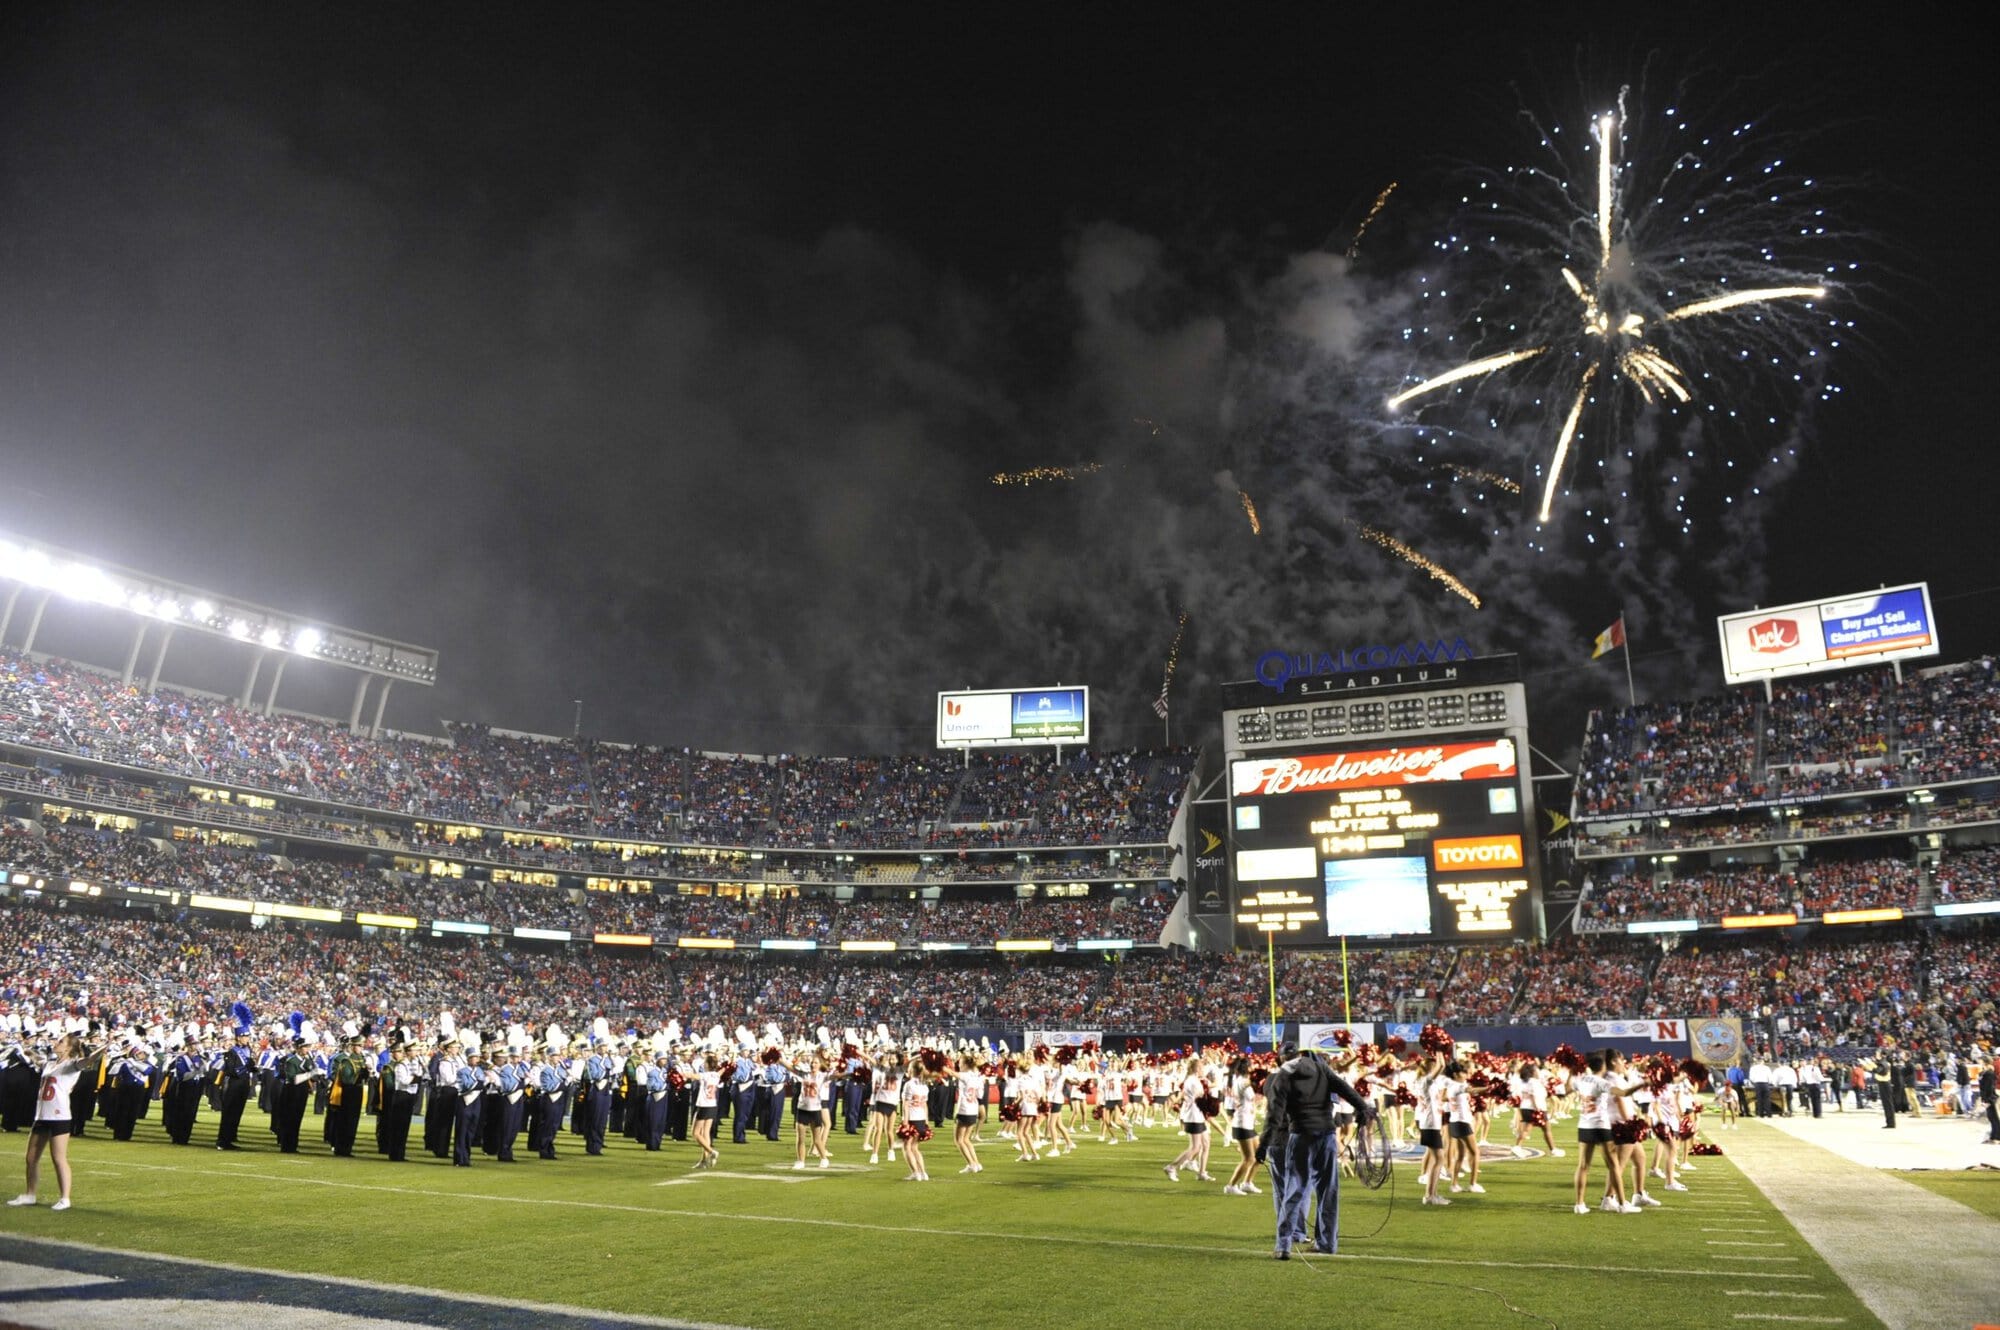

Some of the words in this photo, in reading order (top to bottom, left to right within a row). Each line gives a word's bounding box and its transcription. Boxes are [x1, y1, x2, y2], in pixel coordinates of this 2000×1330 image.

[1842, 618, 1862, 630] Buy
[1864, 613, 1883, 627] and
[1885, 610, 1906, 624] Sell
[1750, 621, 1798, 651] Jack
[1831, 628, 1878, 645] Chargers
[1300, 668, 1457, 692] STADIUM
[947, 724, 980, 732] Union
[1265, 748, 1443, 795] Budweiser
[1384, 788, 1401, 800] TO
[1330, 805, 1352, 818] DR
[1355, 801, 1412, 817] PEPPER
[1310, 817, 1390, 834] HALFTIME
[1396, 813, 1440, 829] SHOW
[1438, 844, 1517, 864] TOYOTA
[1196, 857, 1225, 870] Sprint
[1657, 1021, 1678, 1039] N
[1031, 1033, 1044, 1048] A
